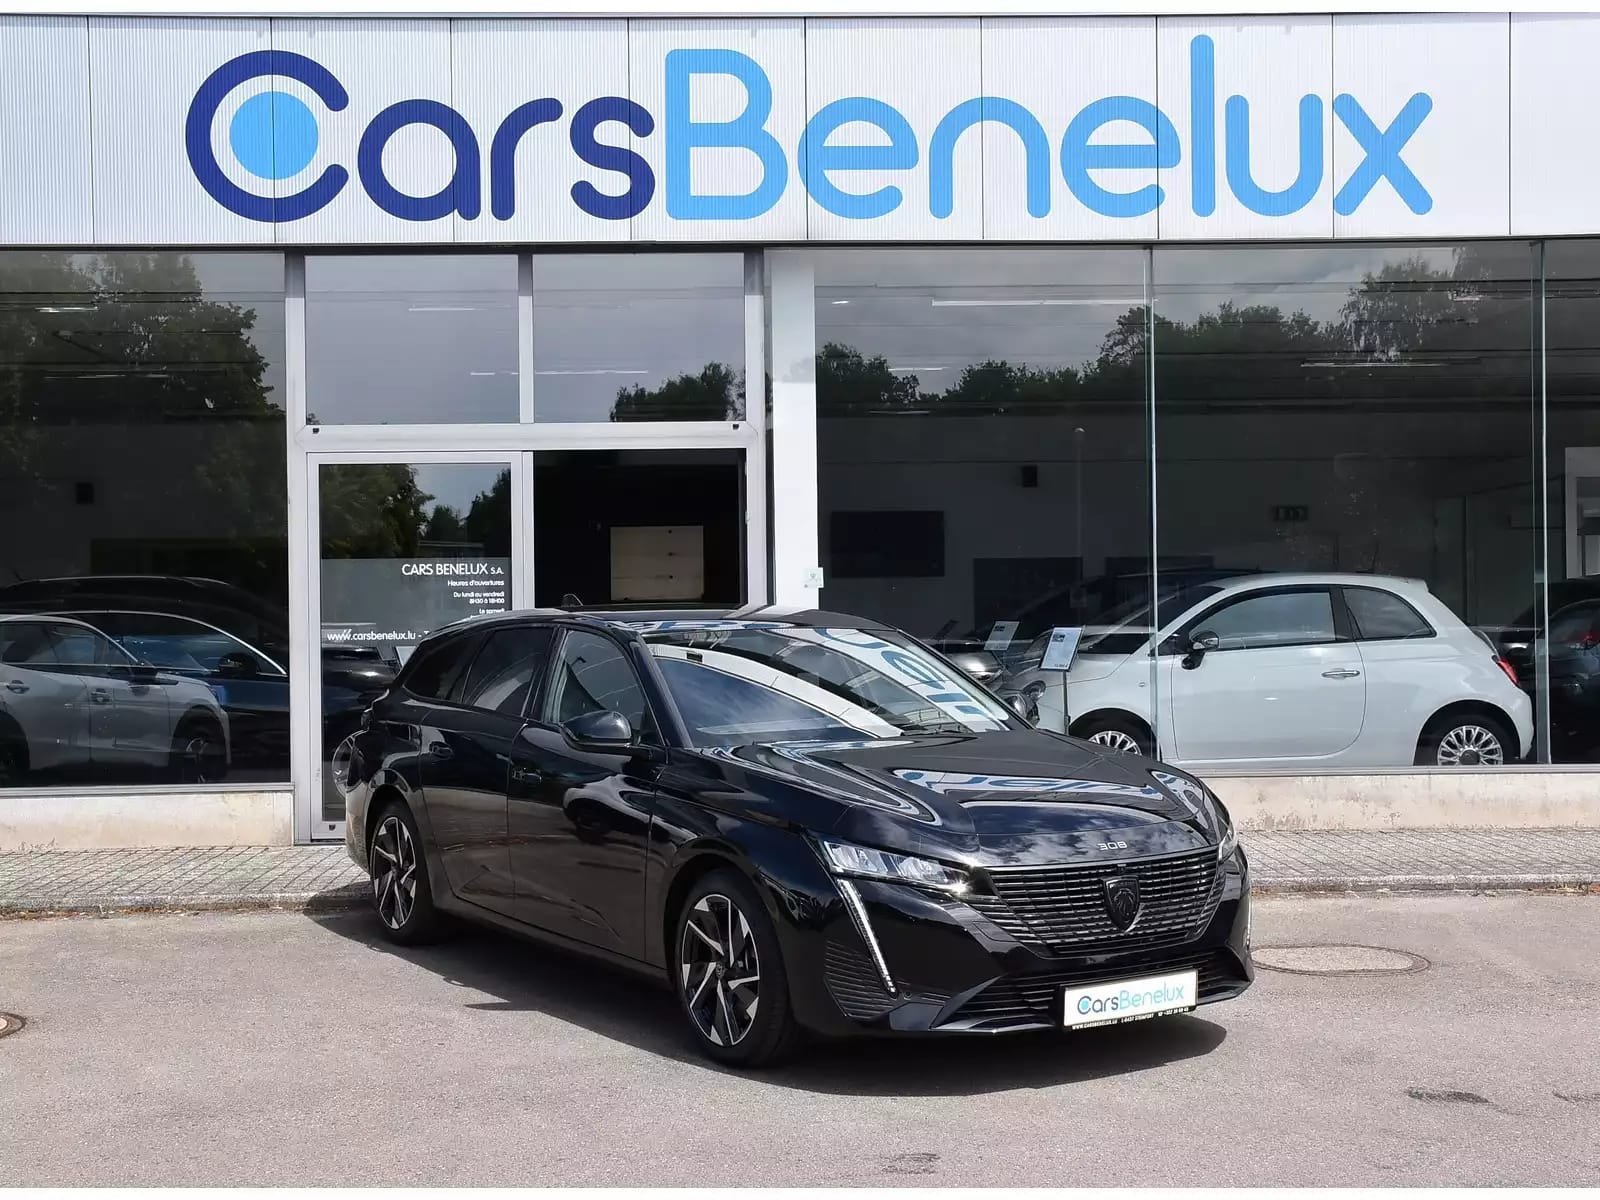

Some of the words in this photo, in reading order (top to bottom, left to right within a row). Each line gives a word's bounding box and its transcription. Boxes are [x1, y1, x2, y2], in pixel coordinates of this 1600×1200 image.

[185, 35, 1434, 222] CarsBenelux
[401, 563, 434, 576] CARS
[435, 563, 489, 575] BENELUX
[326, 630, 416, 641] www.carsbenelux.lu
[1096, 841, 1128, 851] 308
[1077, 982, 1185, 1015] CarsBenelux
